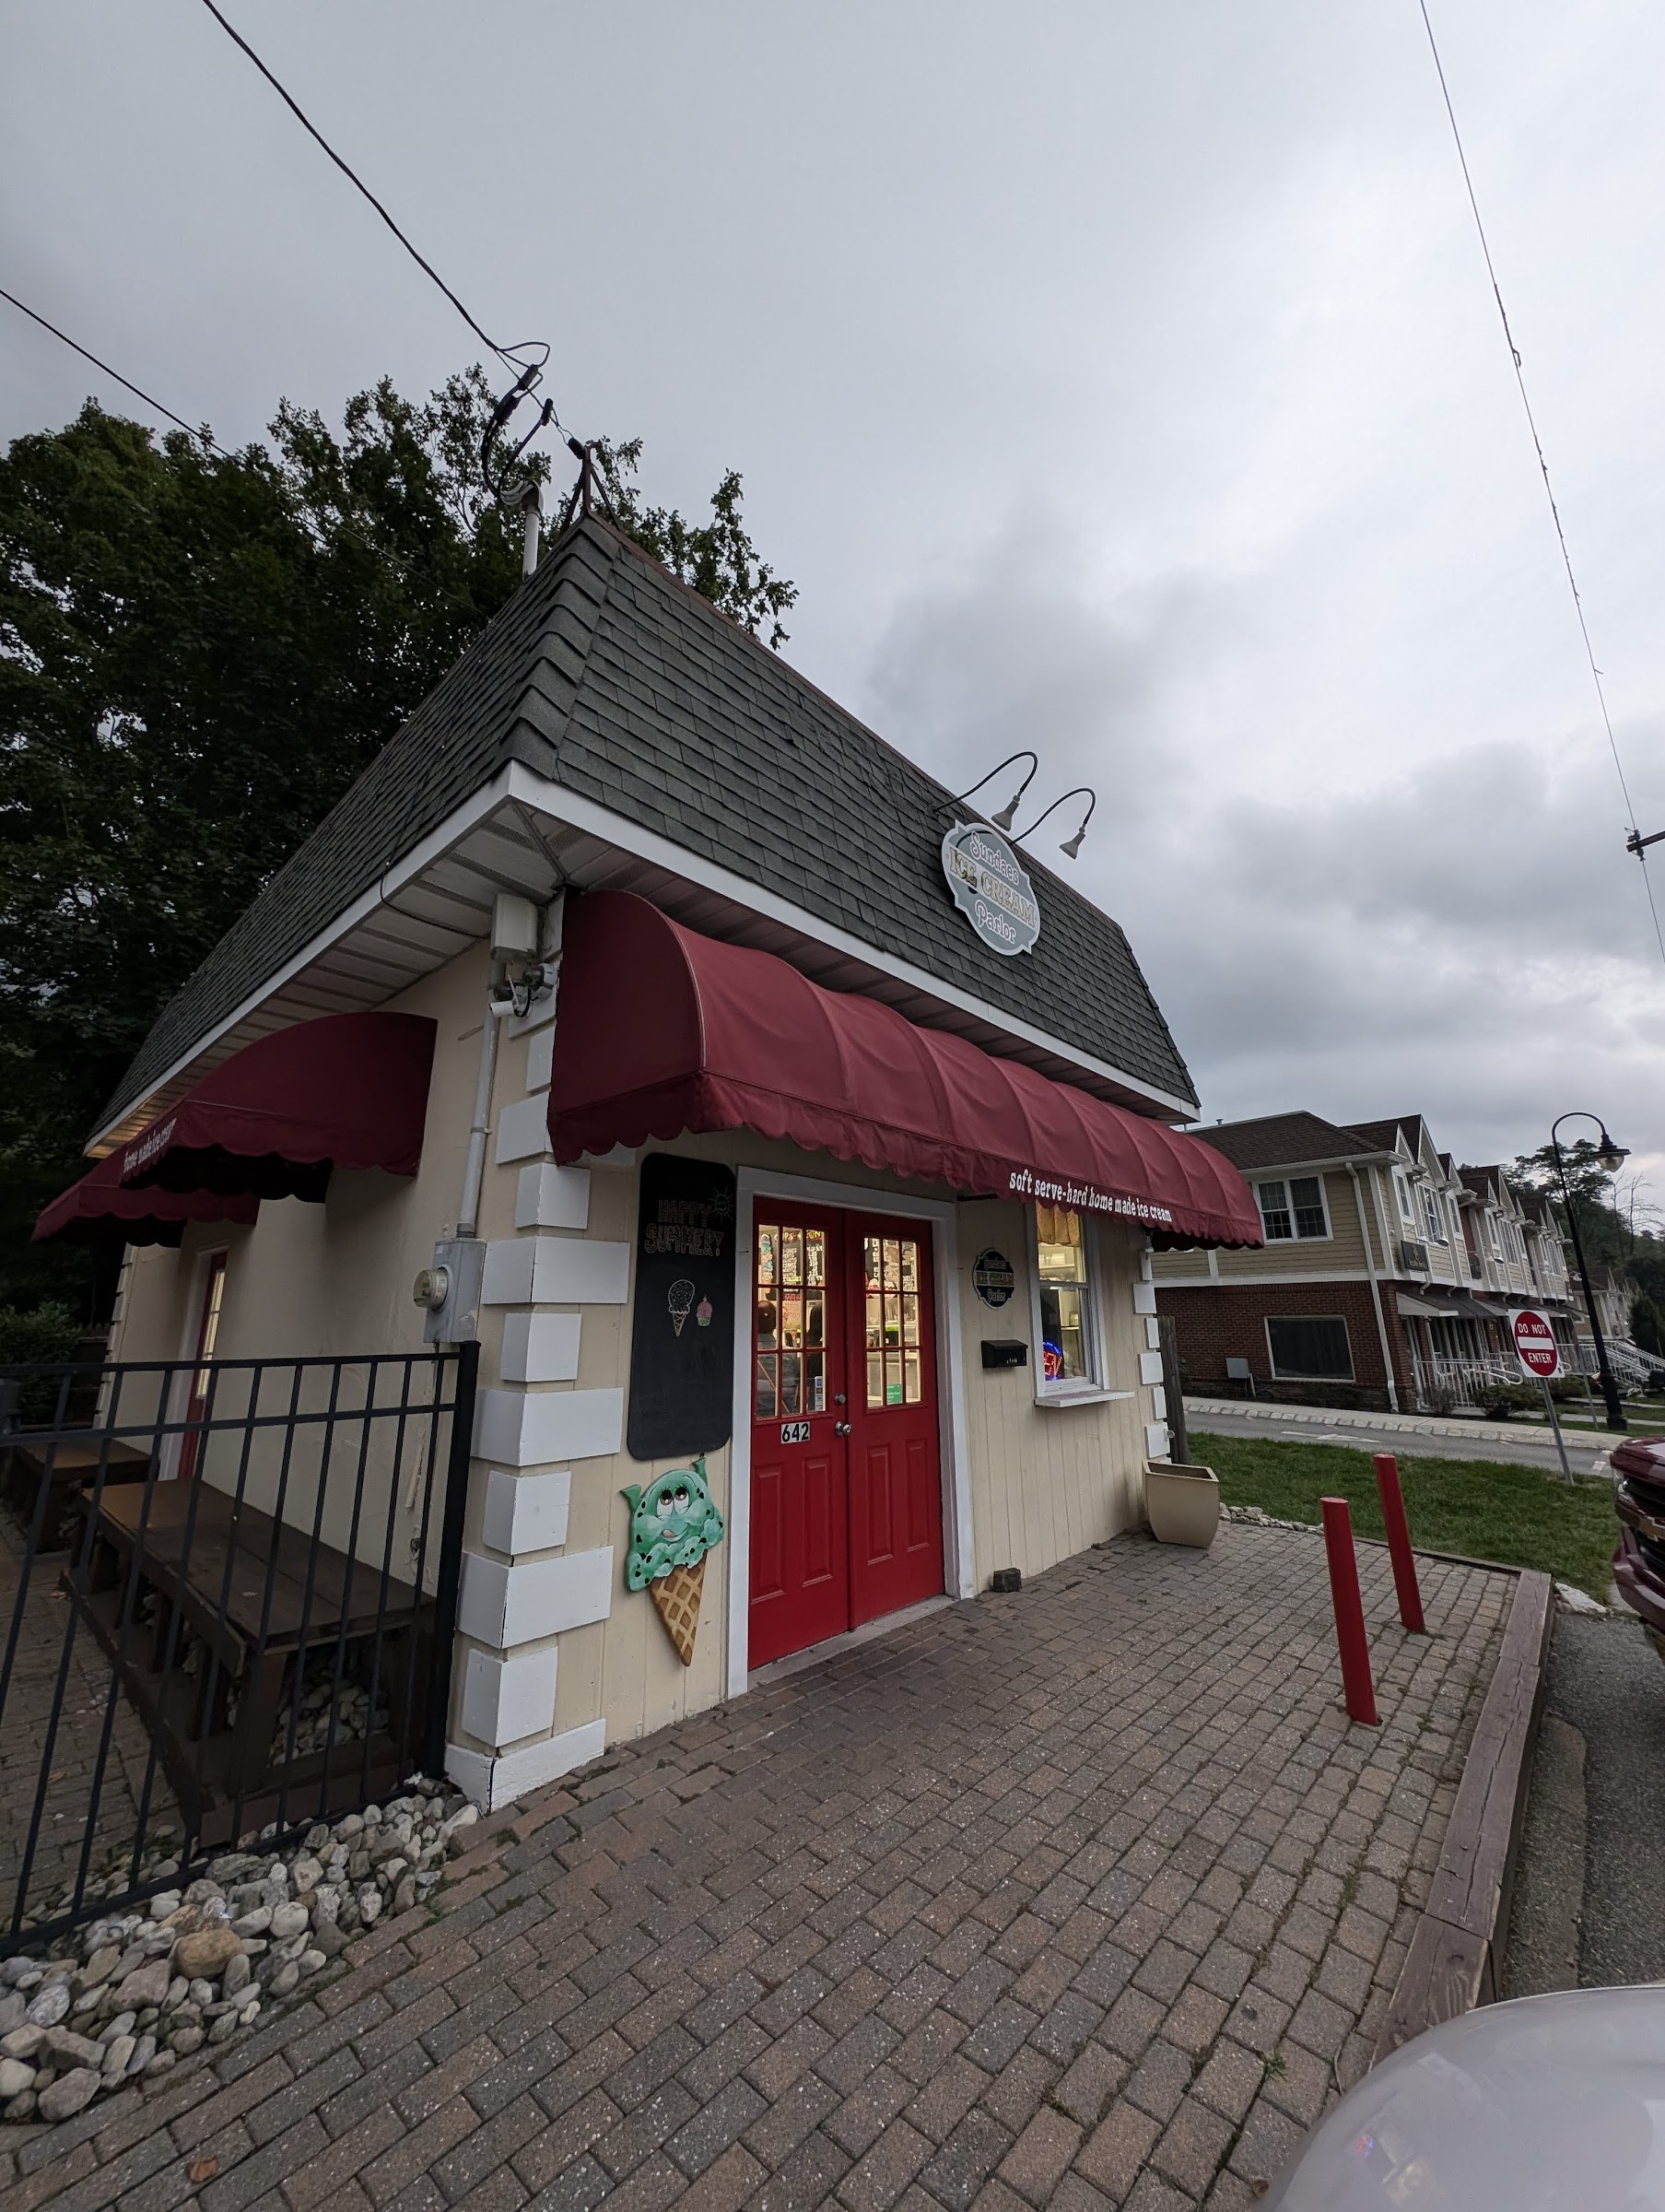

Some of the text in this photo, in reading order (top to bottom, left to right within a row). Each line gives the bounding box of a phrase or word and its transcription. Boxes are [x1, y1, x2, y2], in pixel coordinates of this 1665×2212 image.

[970, 831, 1019, 885] Sundaes
[949, 847, 1035, 928] ICE CREAM
[975, 900, 1016, 944] Parlor
[1009, 1169, 1033, 1193] soft
[1088, 1186, 1113, 1211] home
[1114, 1196, 1136, 1216] made
[1136, 1197, 1149, 1218] ice
[1149, 1206, 1172, 1222] cream
[658, 1199, 712, 1227] HAPPY
[644, 1222, 724, 1256] SUMMER!
[1517, 1323, 1546, 1335] DO NOT
[1527, 1352, 1553, 1363] ENTER
[781, 1422, 810, 1443] 642
